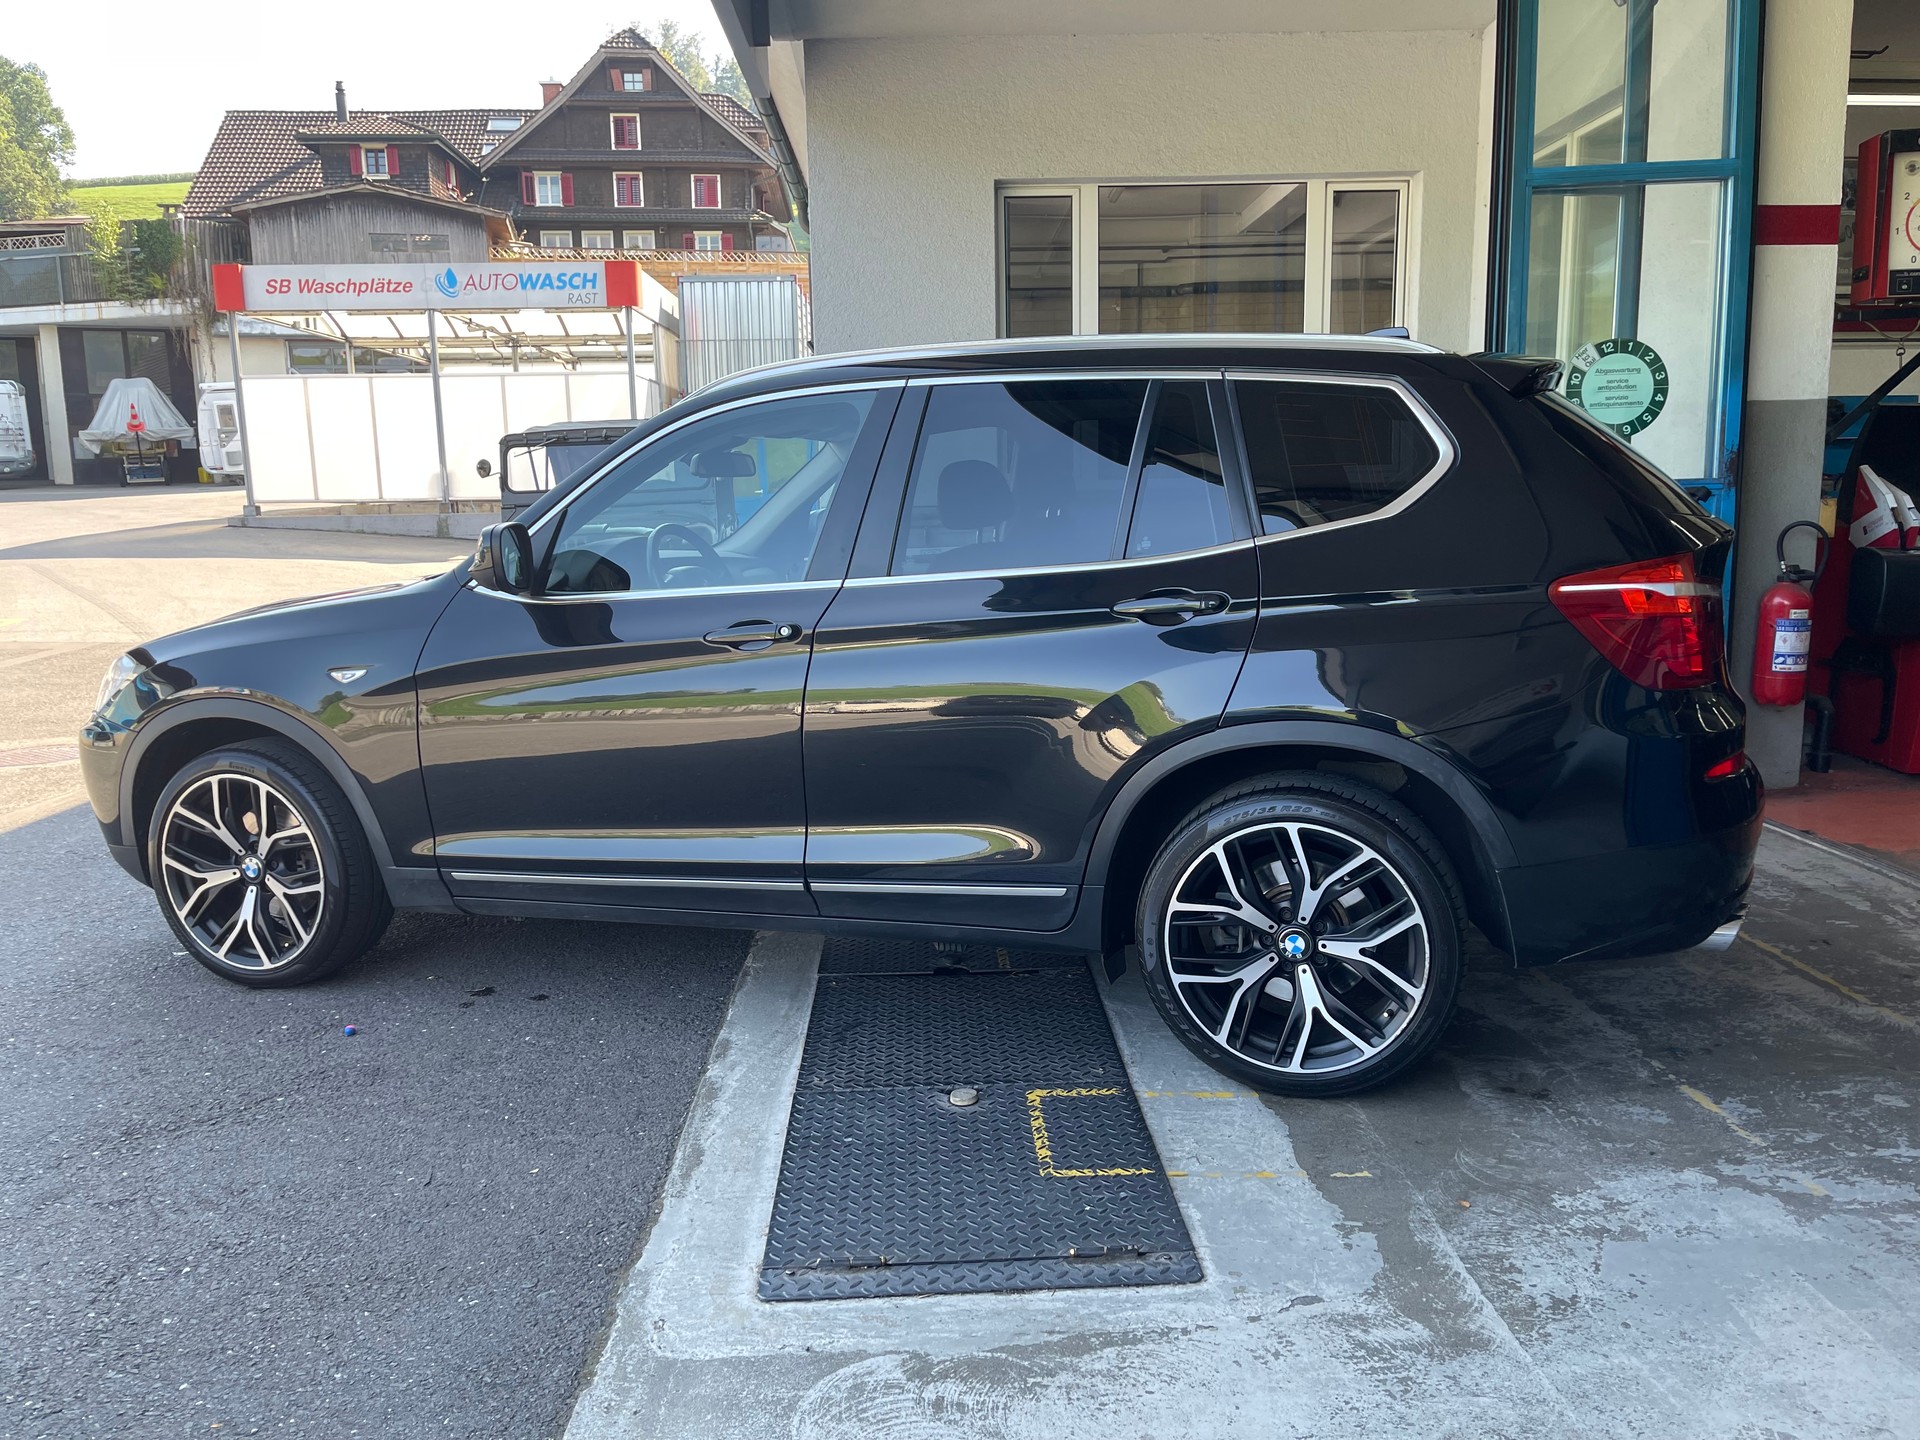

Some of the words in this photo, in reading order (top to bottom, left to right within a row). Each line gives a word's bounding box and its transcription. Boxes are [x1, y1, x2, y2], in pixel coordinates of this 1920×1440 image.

[1904, 192, 1910, 200] 2
[1911, 256, 1917, 264] 0
[265, 278, 292, 294] SB
[298, 277, 414, 297] Waschplätze
[463, 272, 598, 291] AUTOWASCH
[567, 292, 599, 306] RAST
[1601, 342, 1615, 354] 12
[1627, 342, 1634, 352] 1
[1575, 347, 1588, 360] Hier
[1644, 352, 1655, 363] 2
[1570, 373, 1582, 386] 10
[1655, 371, 1666, 380] 3
[1654, 393, 1665, 402] 4
[1643, 413, 1652, 422] 5
